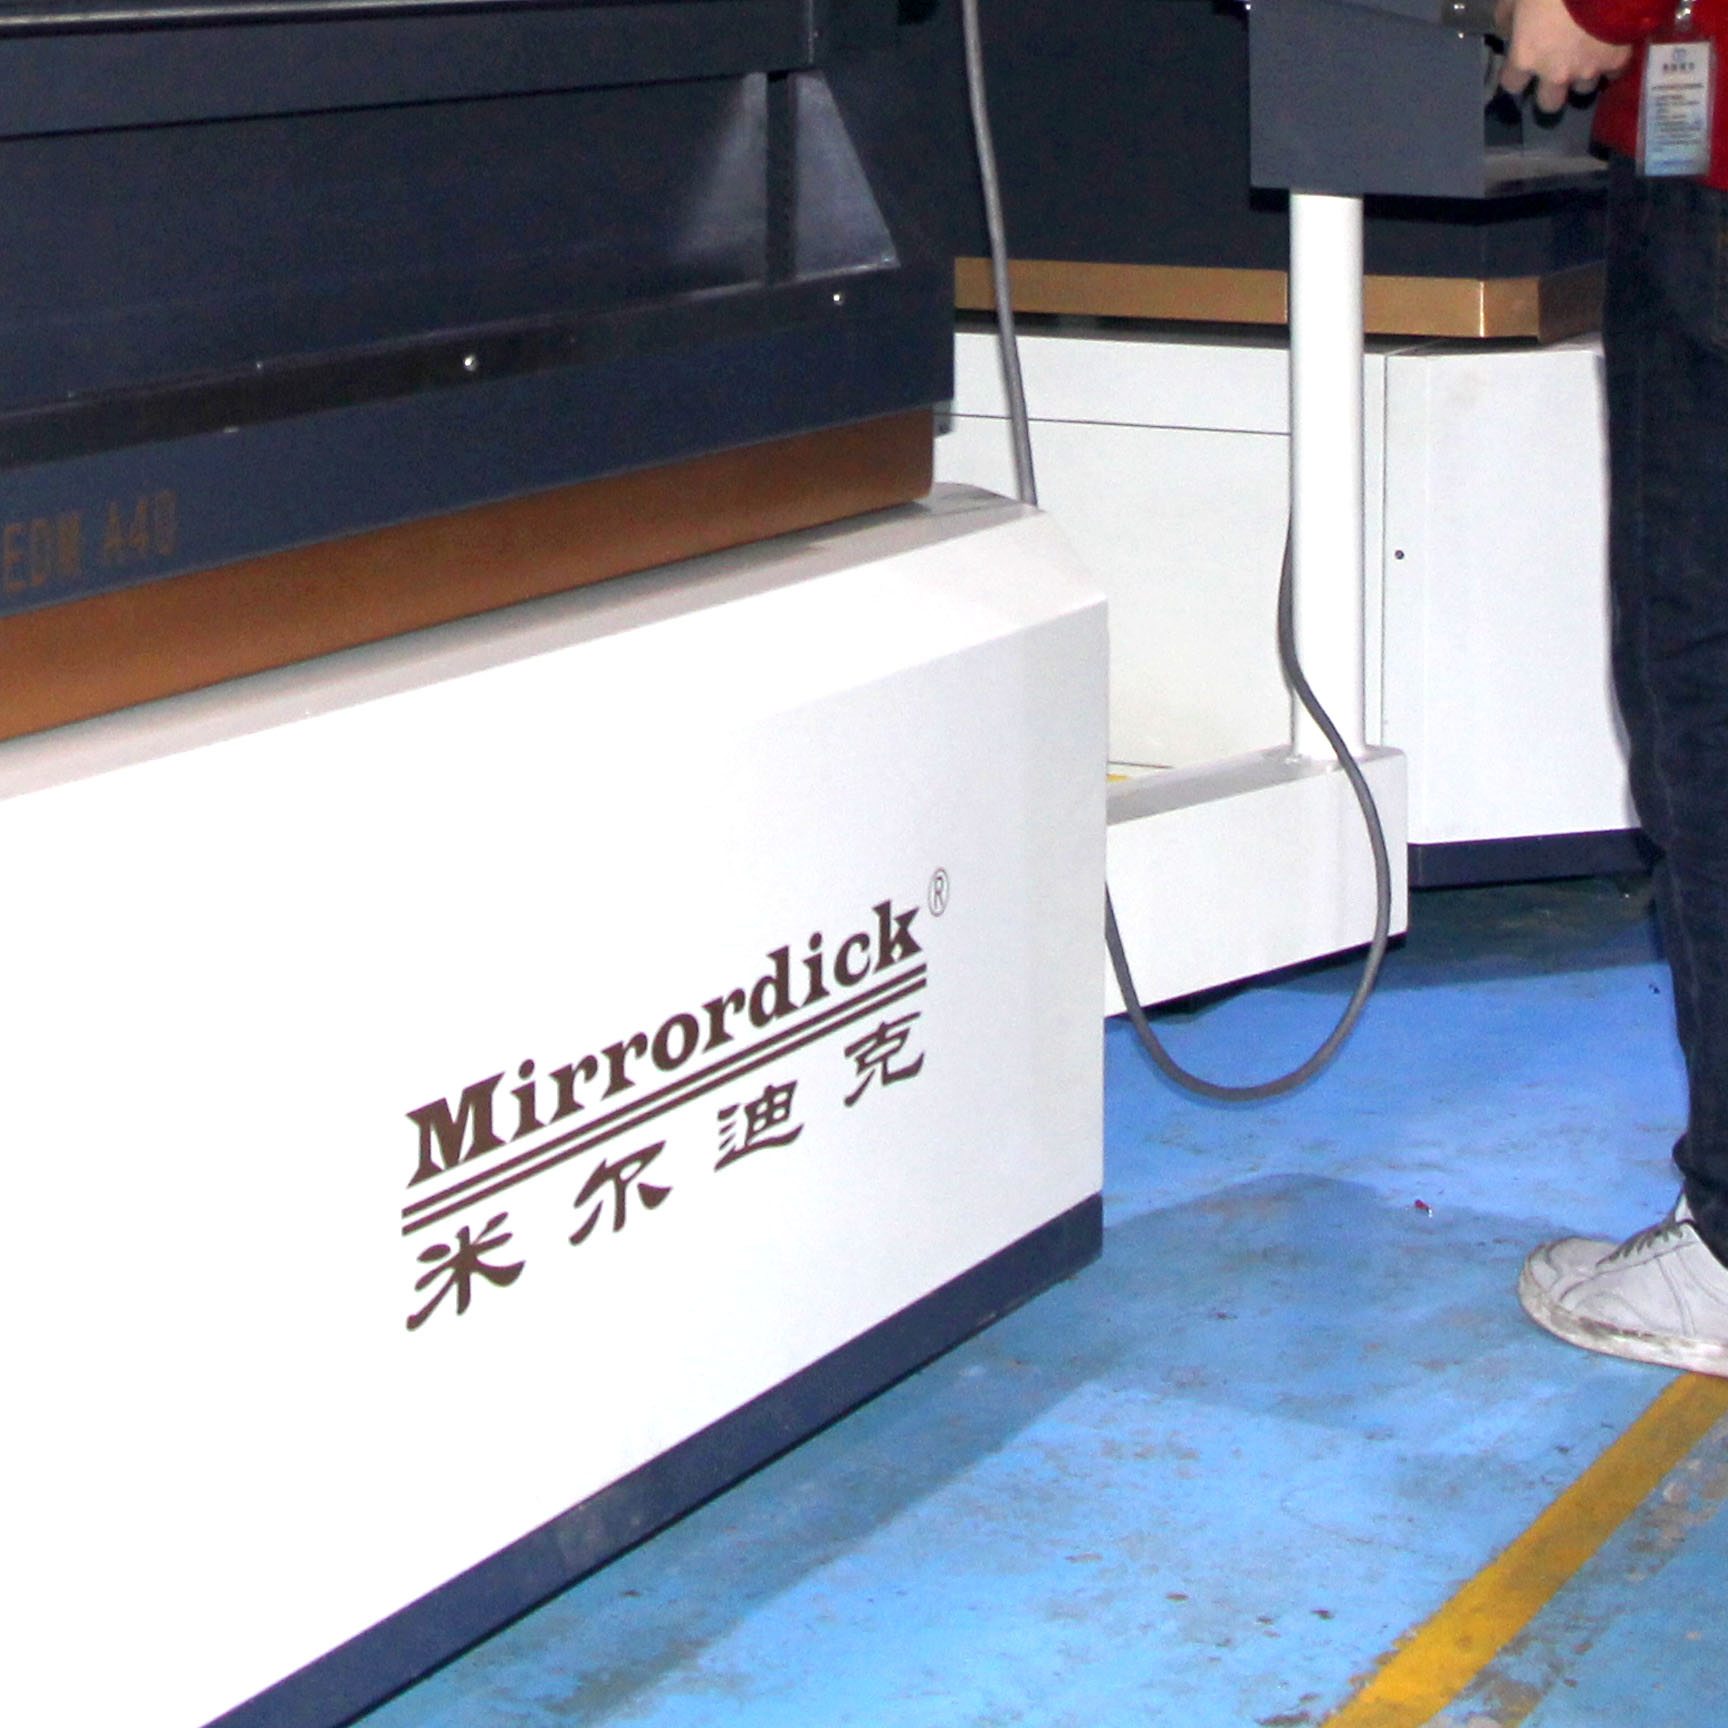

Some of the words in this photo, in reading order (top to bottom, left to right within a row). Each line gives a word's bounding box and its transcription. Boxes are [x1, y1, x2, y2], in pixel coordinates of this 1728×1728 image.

[404, 898, 923, 1189] Mirrordick
[405, 1010, 925, 1332] 米尔迪克
